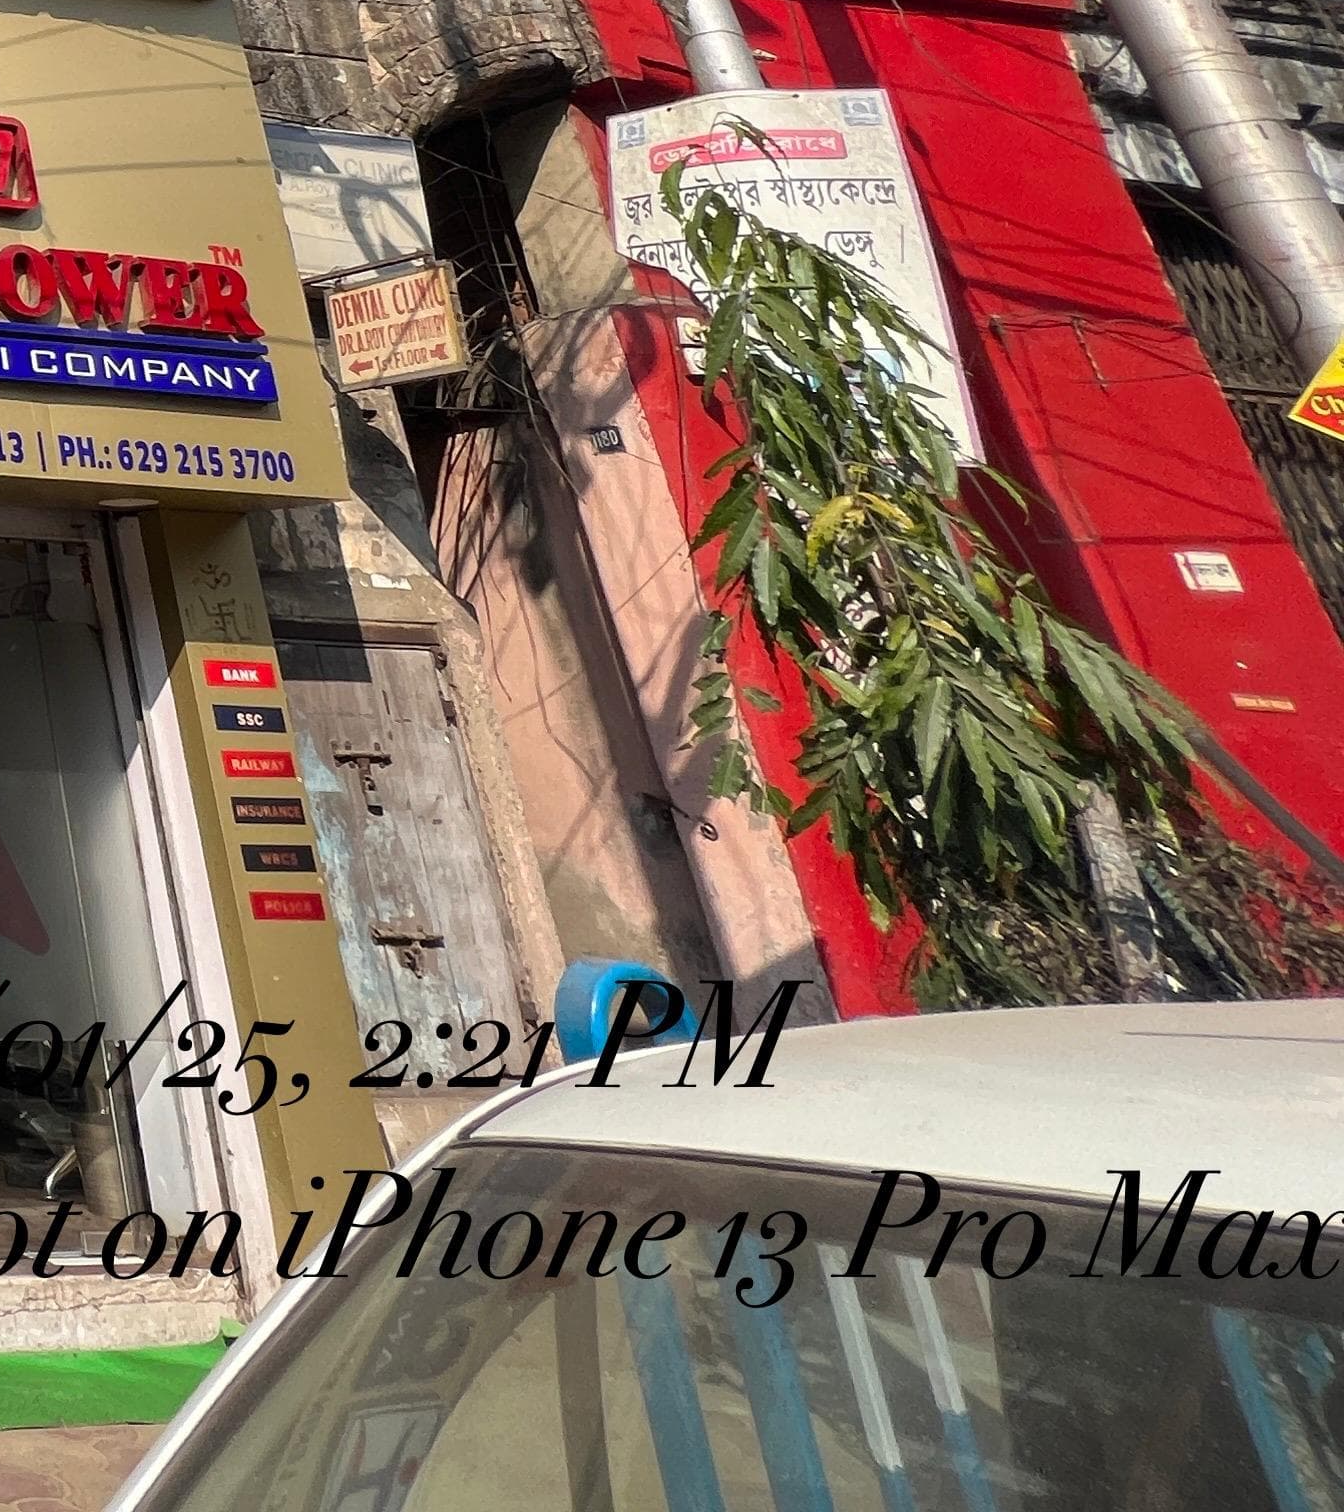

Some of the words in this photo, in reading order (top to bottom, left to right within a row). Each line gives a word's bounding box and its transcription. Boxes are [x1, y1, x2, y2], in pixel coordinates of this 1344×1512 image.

[622, 193, 654, 226] জ্বর
[208, 244, 244, 267] TM
[330, 288, 390, 329] DENTAL
[392, 272, 446, 315] CLINIC
[394, 347, 429, 369] FLOOR
[30, 348, 261, 392] COMPANY
[118, 439, 168, 474] 629
[174, 443, 224, 477] 215
[232, 448, 295, 483] 3700
[220, 668, 260, 683] BANK
[236, 712, 265, 727] SSC
[230, 758, 286, 772] RAILWAY
